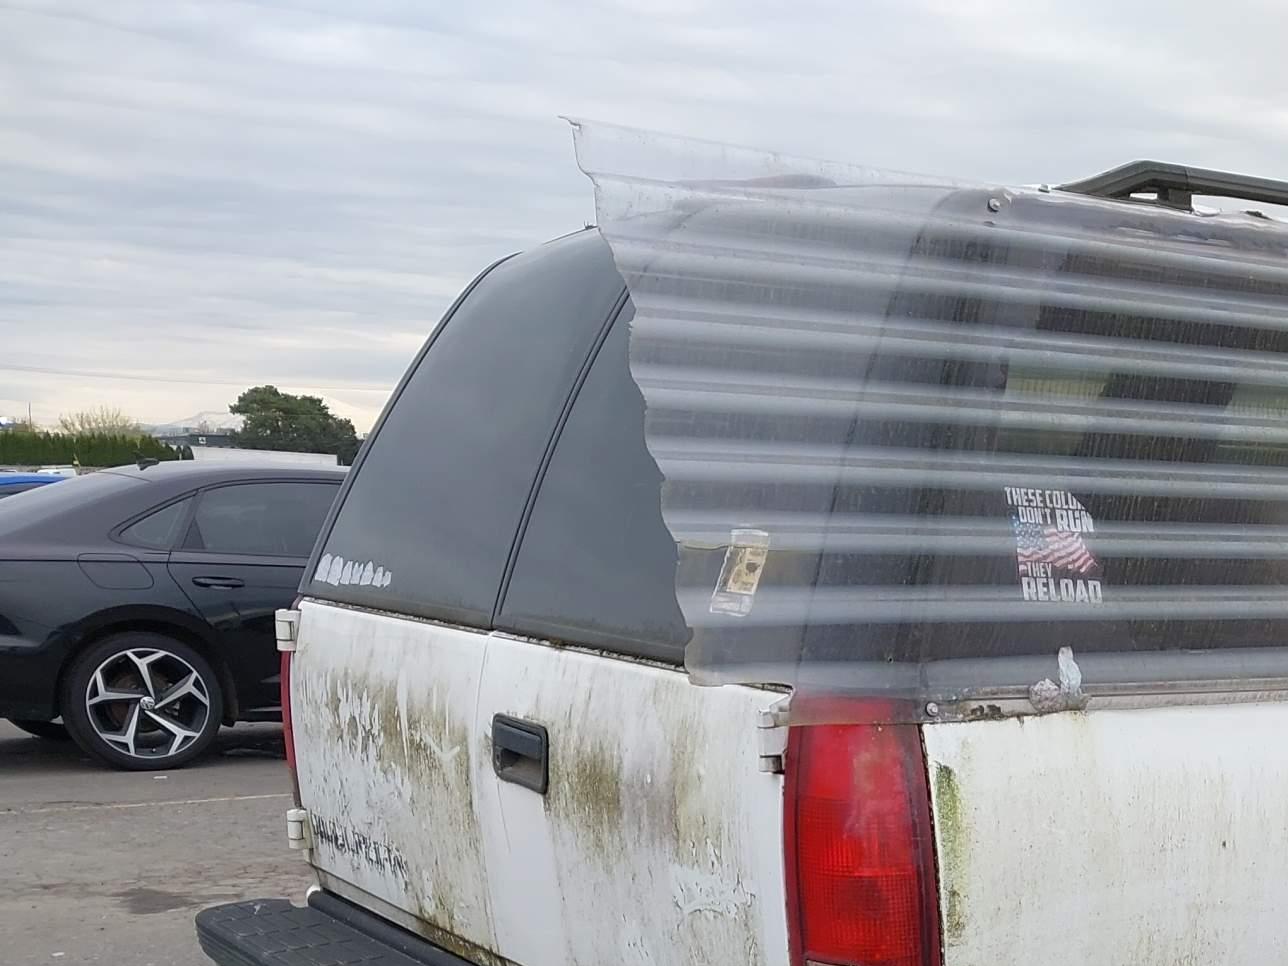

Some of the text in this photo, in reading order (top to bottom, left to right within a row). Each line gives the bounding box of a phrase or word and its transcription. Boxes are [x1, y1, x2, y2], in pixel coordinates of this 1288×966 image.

[1004, 487, 1043, 507] THESE
[1018, 506, 1095, 532] DON'T RUN
[1026, 562, 1052, 577] THEY
[1021, 577, 1103, 603] RELOAD
